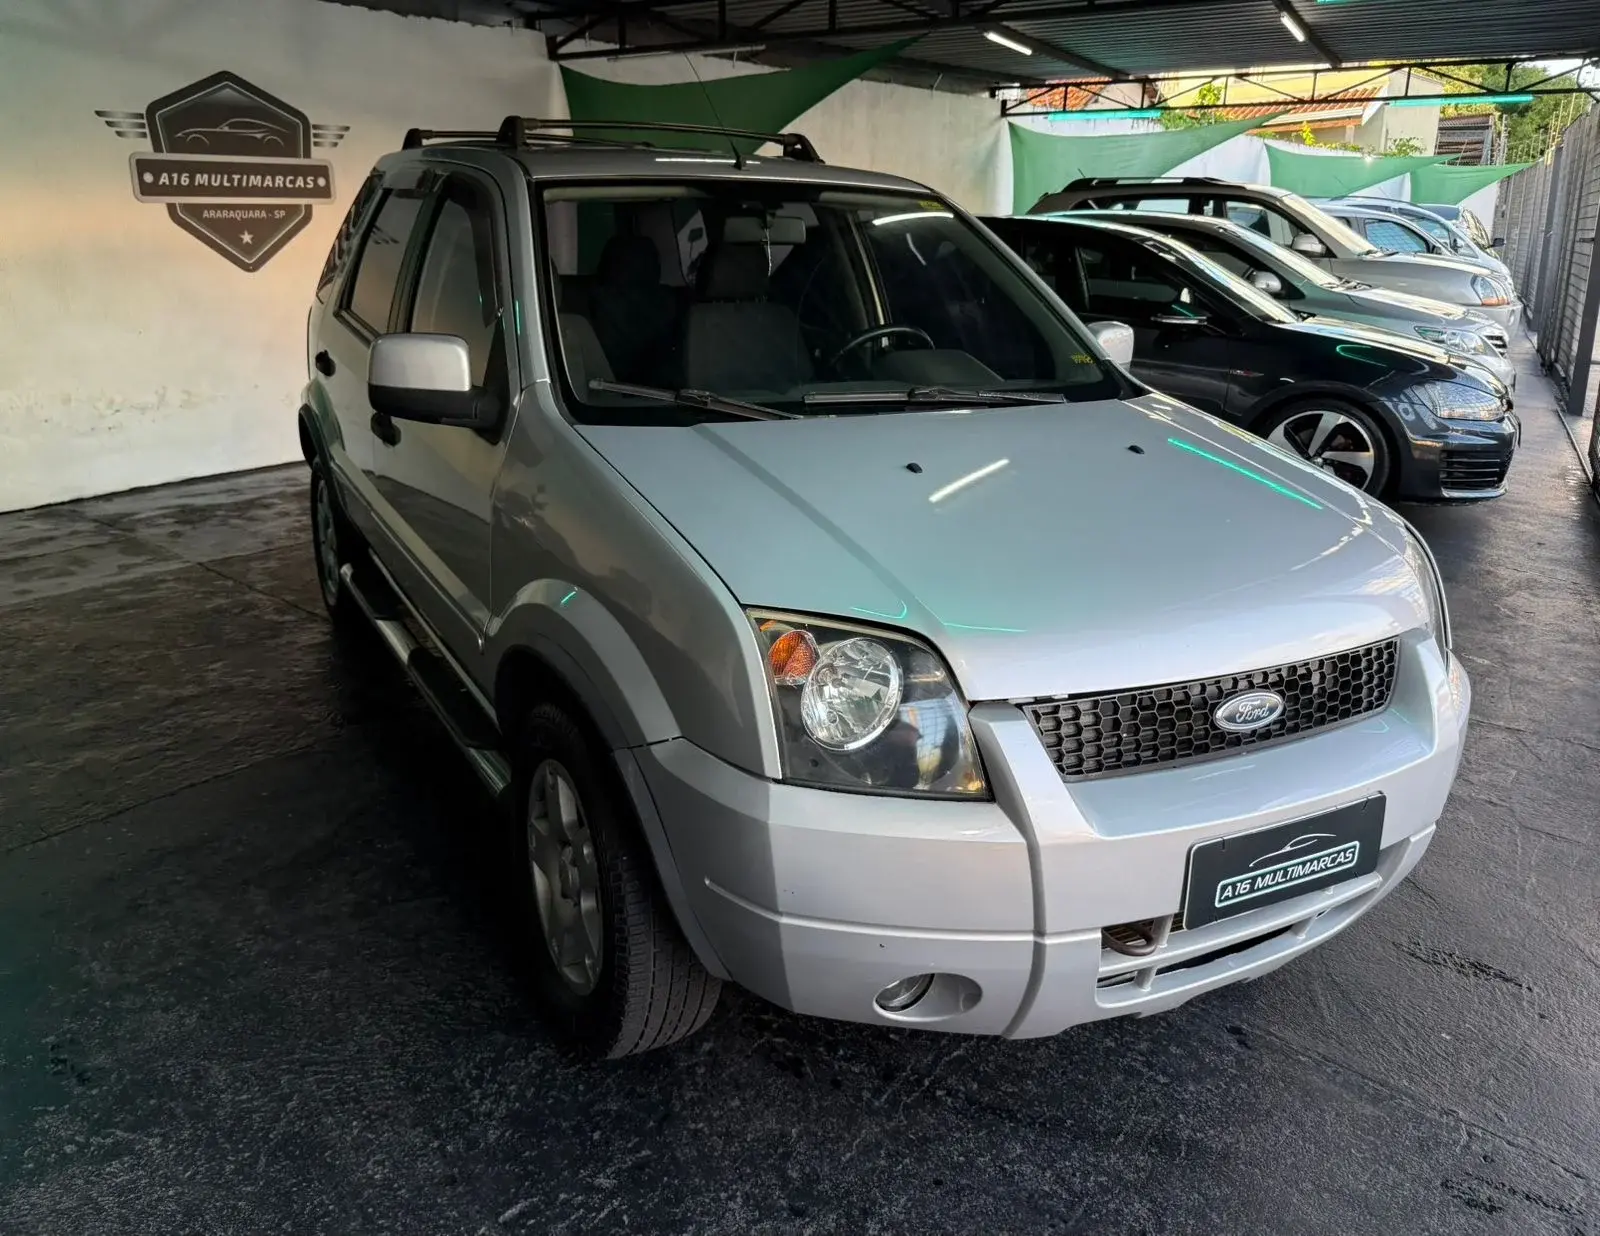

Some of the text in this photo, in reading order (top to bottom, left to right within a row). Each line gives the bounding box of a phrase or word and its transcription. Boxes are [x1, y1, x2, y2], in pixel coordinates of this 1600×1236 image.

[158, 172, 315, 188] A16 MULTIMARCAS
[202, 209, 268, 221] ARARAQUARA
[274, 210, 286, 219] SP
[1236, 700, 1269, 723] Ford
[1221, 849, 1354, 899] A16 MULTIMARCAS
